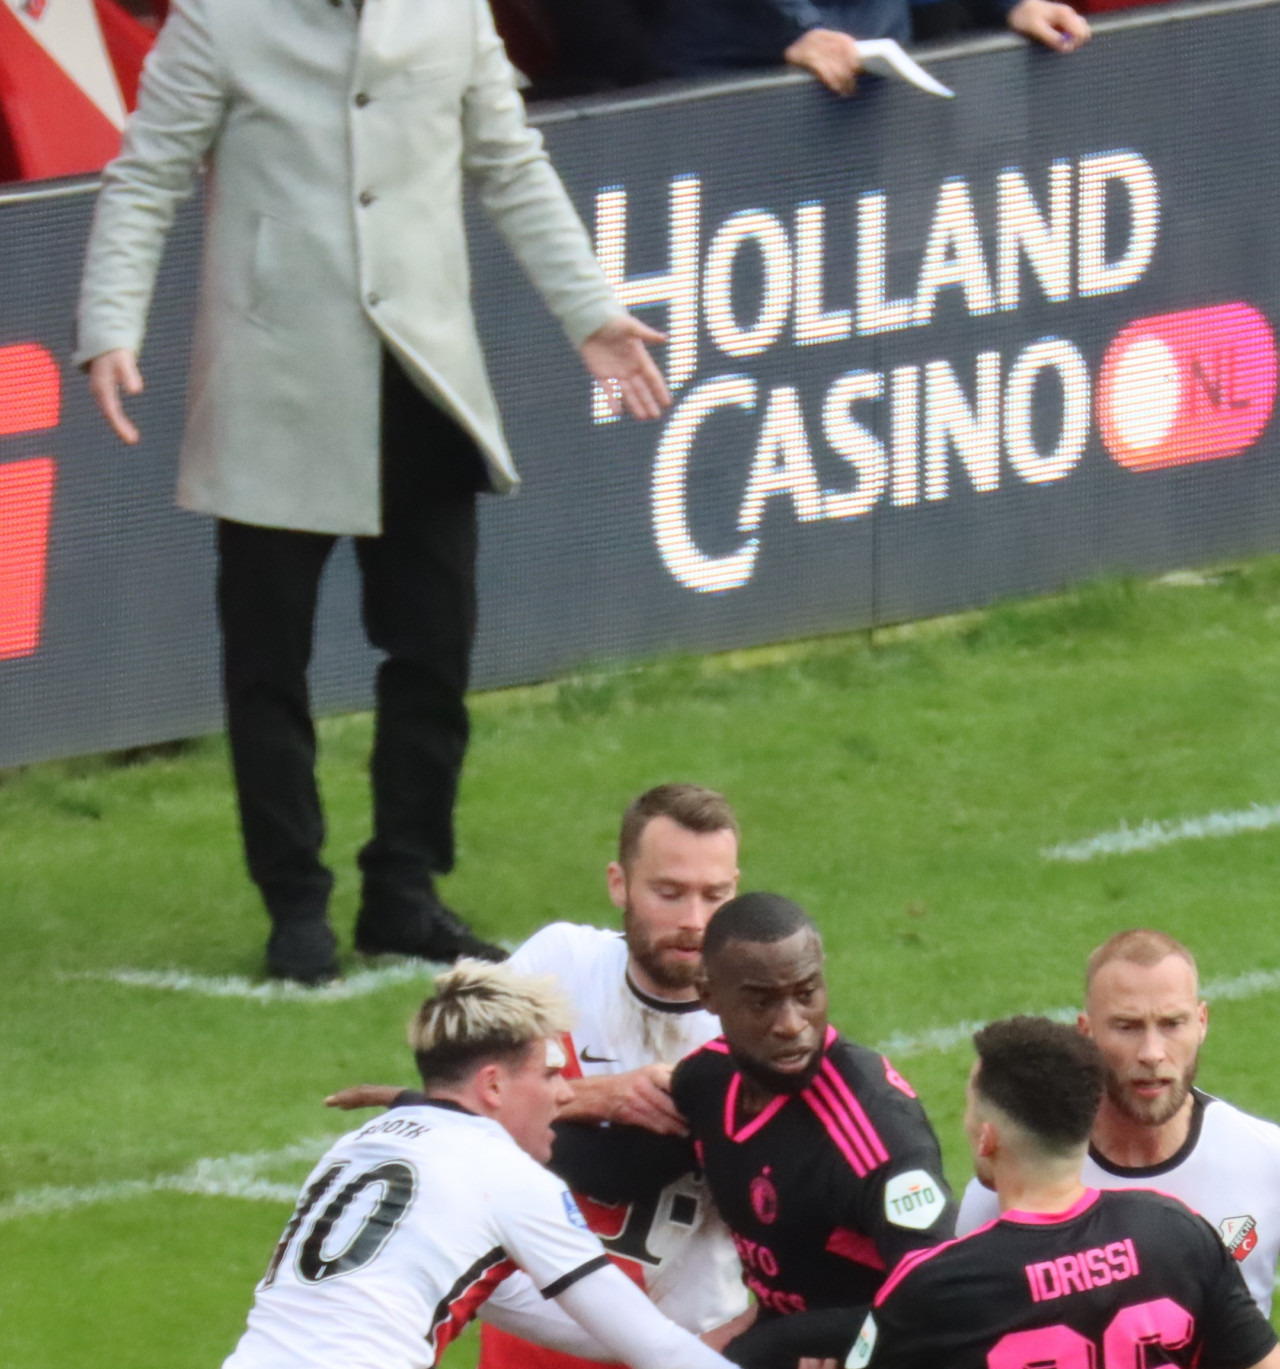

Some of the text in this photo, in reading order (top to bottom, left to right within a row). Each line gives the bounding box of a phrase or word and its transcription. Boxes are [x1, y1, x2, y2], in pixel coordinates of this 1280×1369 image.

[593, 148, 1161, 424] HOLLAND
[651, 336, 1092, 594] CASINO
[258, 1159, 419, 1292] 10
[891, 1187, 936, 1216] TOTO
[1025, 1239, 1140, 1303] IDRISSI
